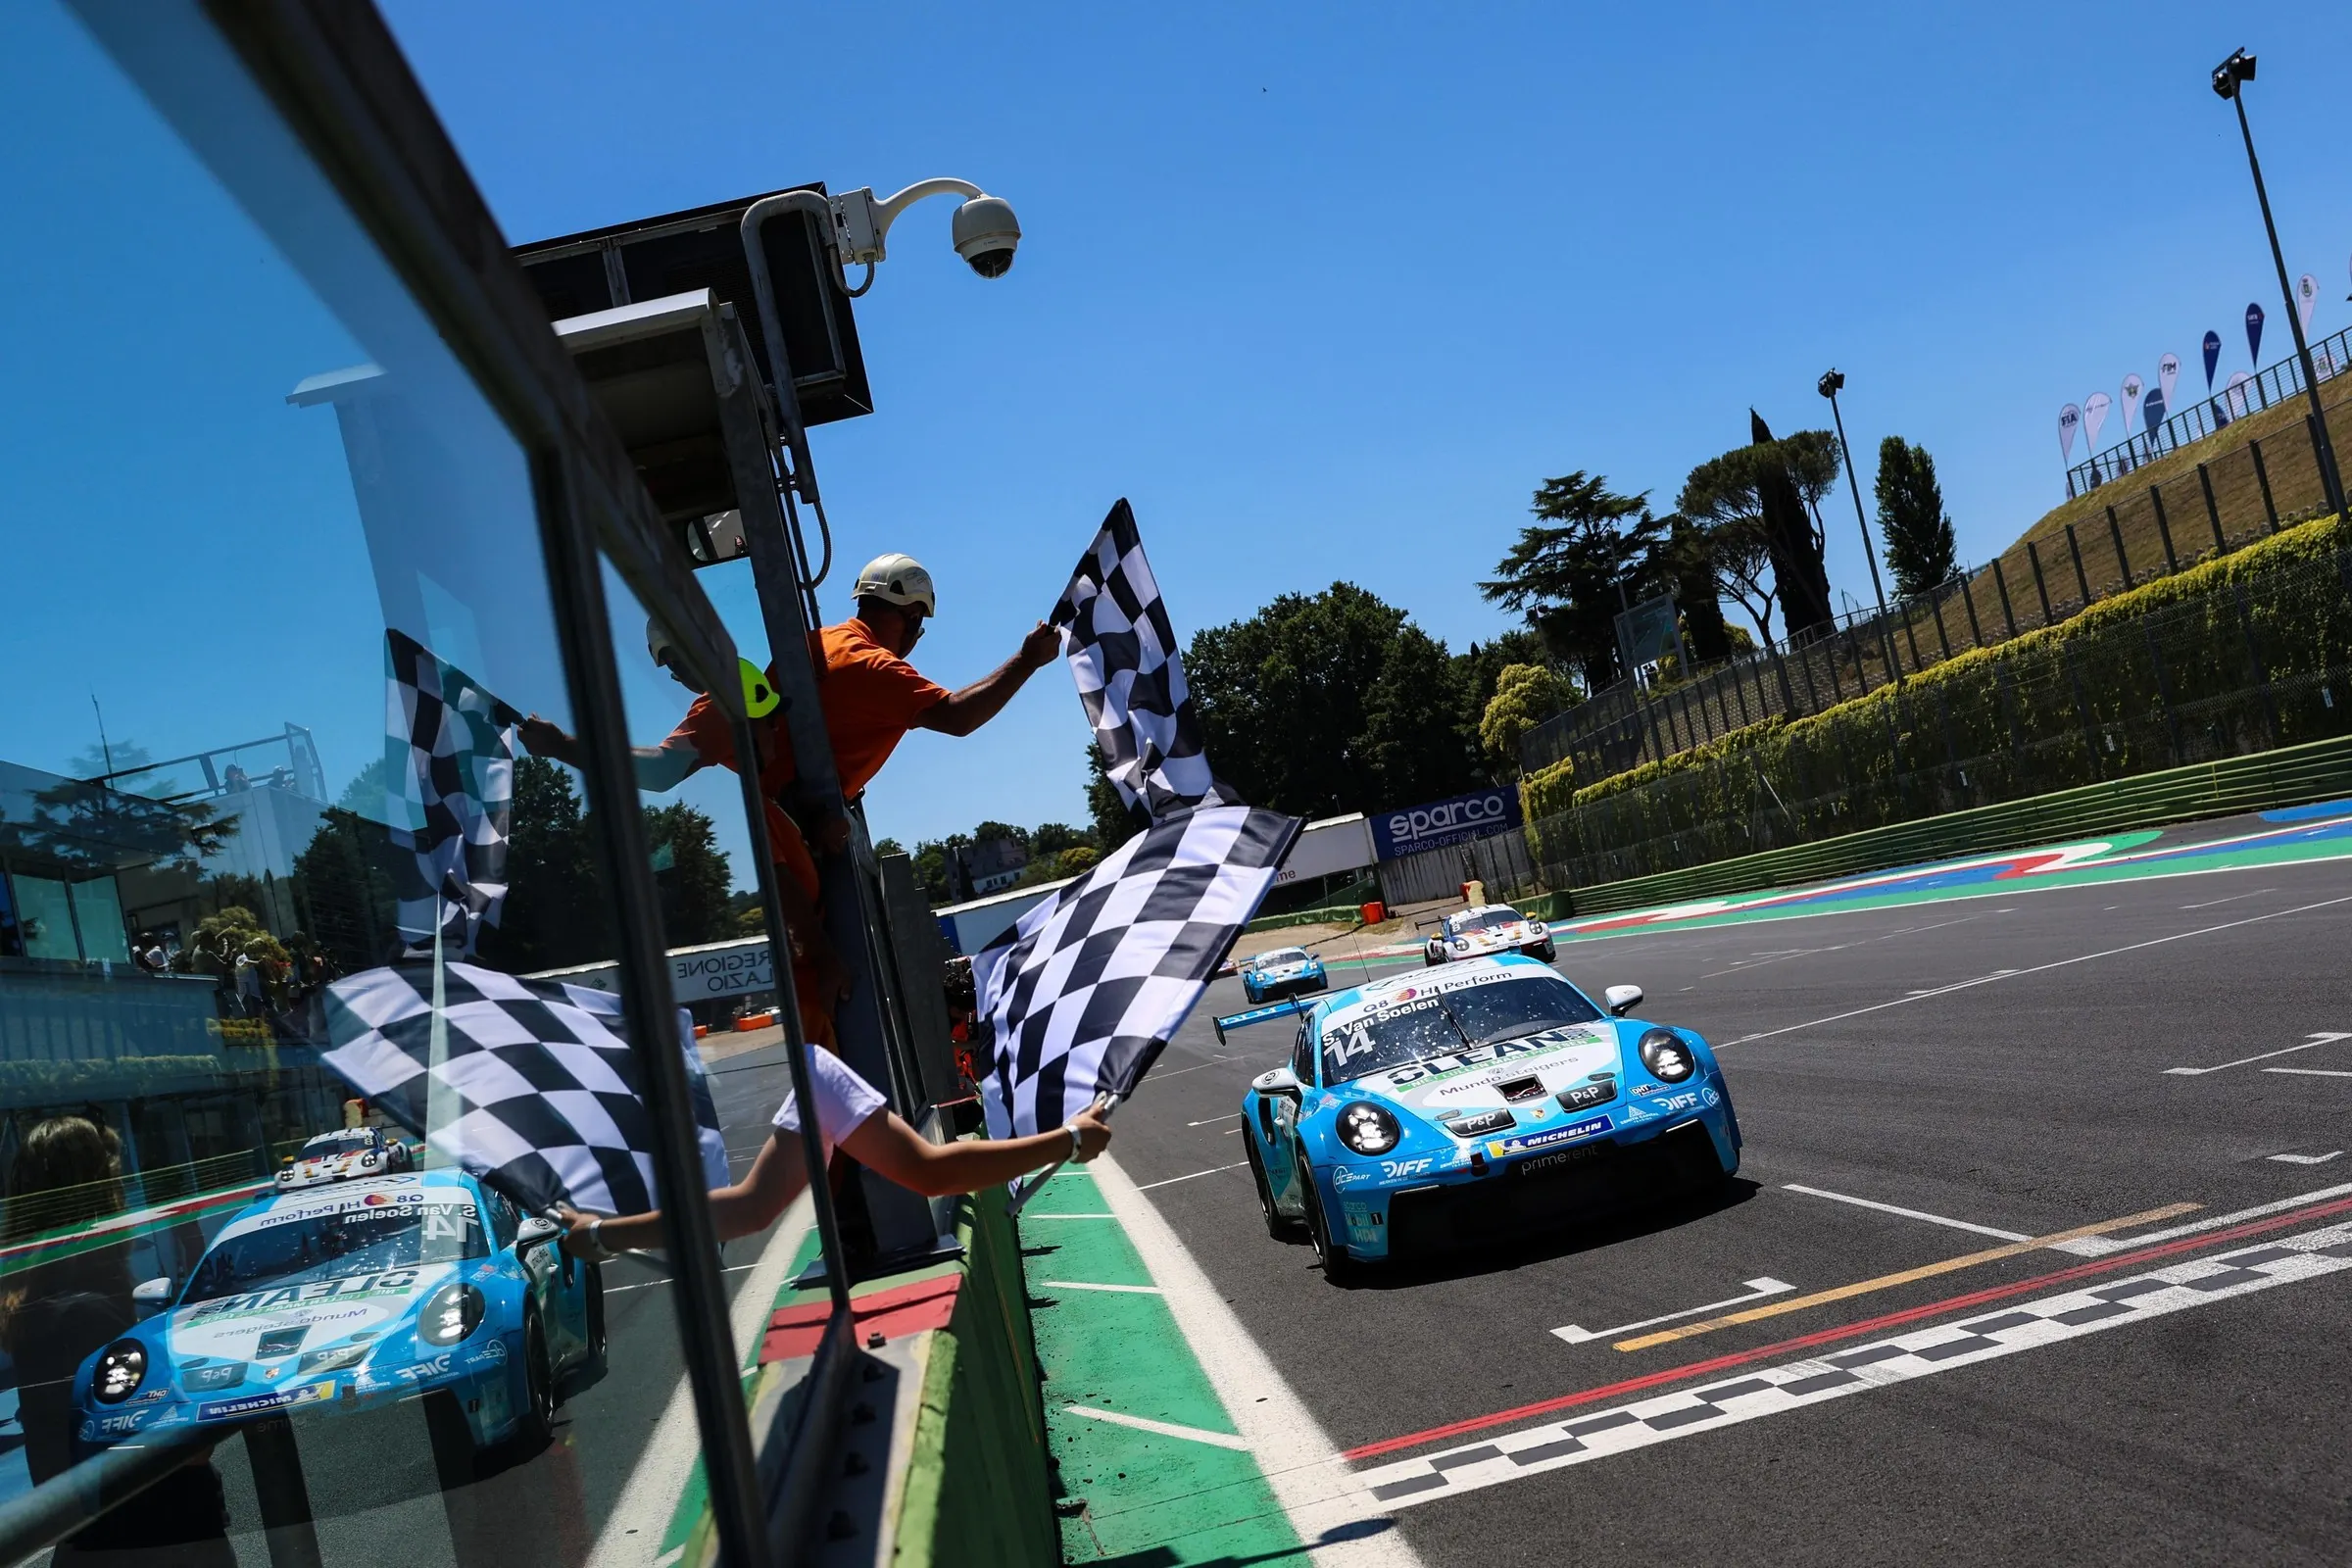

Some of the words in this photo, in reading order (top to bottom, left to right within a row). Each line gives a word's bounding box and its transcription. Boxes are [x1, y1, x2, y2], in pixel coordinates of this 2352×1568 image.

[2061, 413, 2078, 426] FIA
[1389, 795, 1504, 841] sparco
[1394, 822, 1509, 857] SPARCO-OFFICIAL.COM
[1363, 1000, 1389, 1013] Q8
[1445, 971, 1512, 991] Perform
[1323, 1033, 1340, 1047] S.
[1341, 1013, 1374, 1035] Van
[1378, 999, 1440, 1022] Soelen
[1323, 1029, 1377, 1067] 14
[1388, 1031, 1569, 1085] CLEAN
[1440, 1075, 1501, 1096] Mundo
[1570, 1087, 1599, 1103] P&P
[1631, 1084, 1649, 1094] DHT
[1651, 1093, 1697, 1110] DIFF
[1467, 1113, 1496, 1130] P&P
[1528, 1122, 1601, 1146] MICHELIN
[1381, 1158, 1433, 1179] DIFF
[1522, 1145, 1597, 1175] primerent
